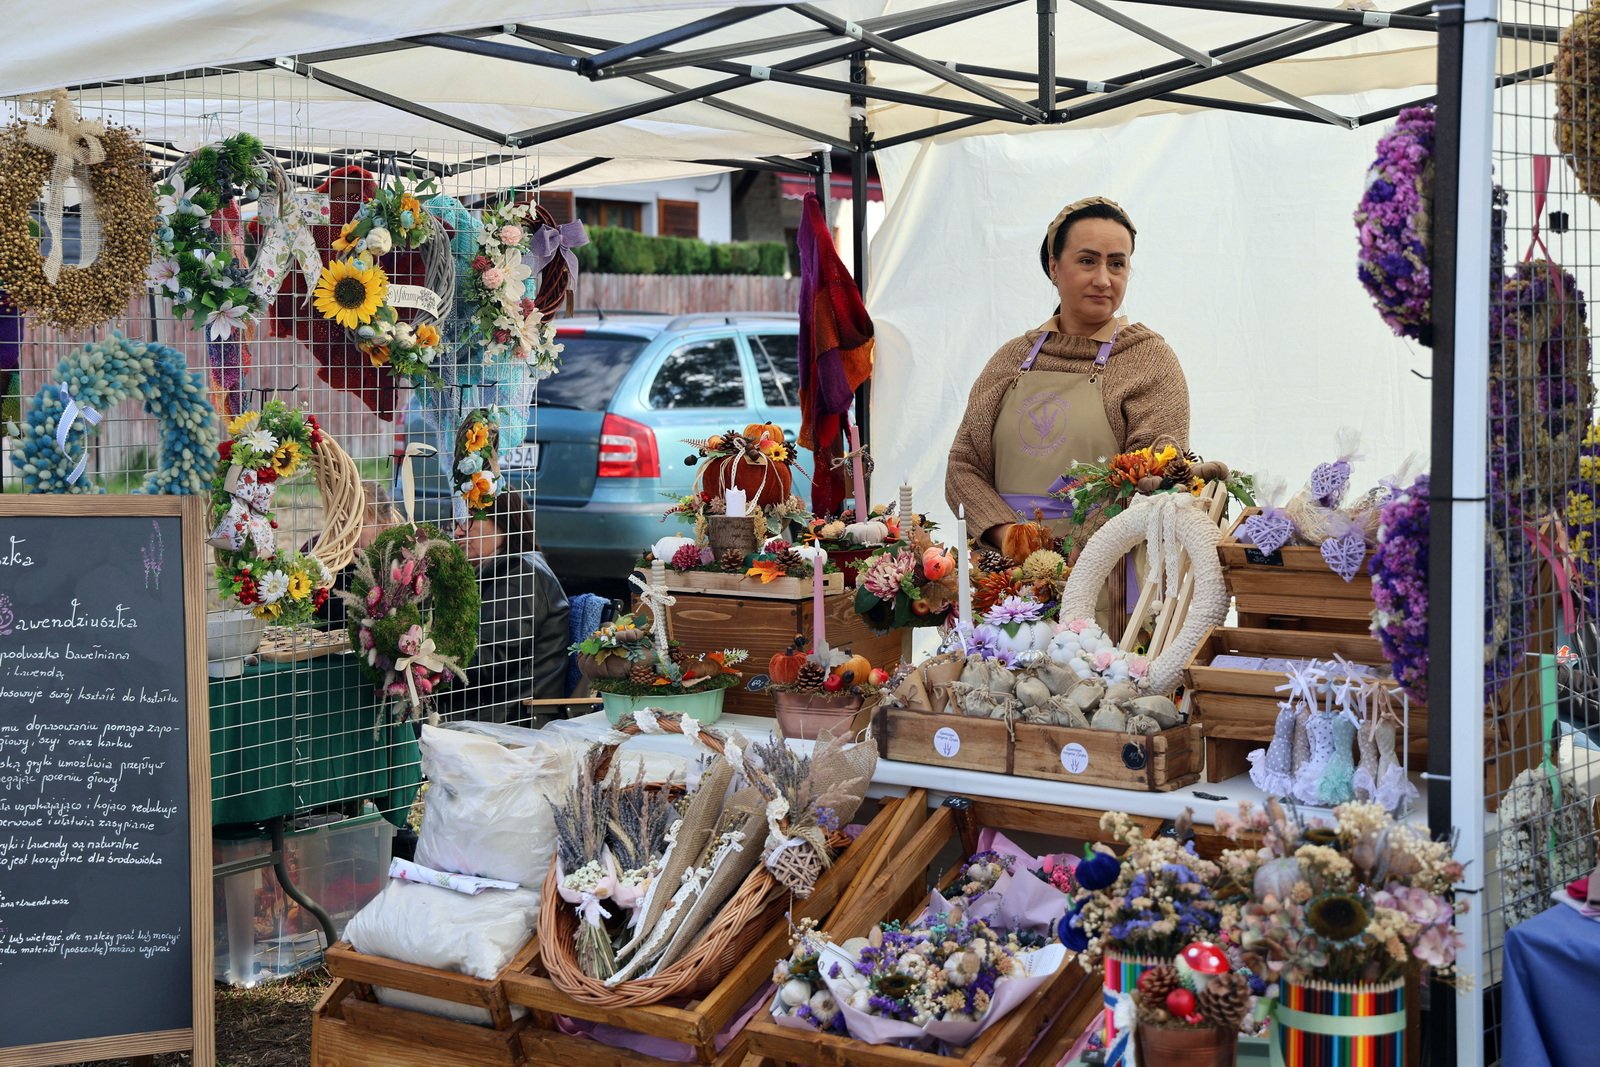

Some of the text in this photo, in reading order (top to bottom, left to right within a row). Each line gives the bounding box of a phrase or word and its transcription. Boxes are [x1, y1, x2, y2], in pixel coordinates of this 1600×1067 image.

[0, 535, 35, 567] zka
[49, 687, 73, 705] swój
[122, 687, 136, 702] do
[26, 714, 98, 737] dopasowaniu
[103, 723, 144, 738] pomaga
[39, 734, 60, 752] szyi
[98, 734, 133, 748] karku
[25, 754, 53, 775] gryki
[58, 753, 113, 768] umożliwia
[41, 772, 83, 794] poceniu
[15, 797, 82, 817] uspokajająco
[94, 794, 127, 816] kojąco
[131, 797, 178, 819] redukuje
[99, 819, 155, 836] zasypianie
[72, 841, 86, 852] są
[87, 836, 140, 850] naturalne
[8, 855, 29, 871] jest
[31, 853, 84, 870] korzystne
[87, 852, 105, 863] dla
[107, 851, 163, 865] środowiska
